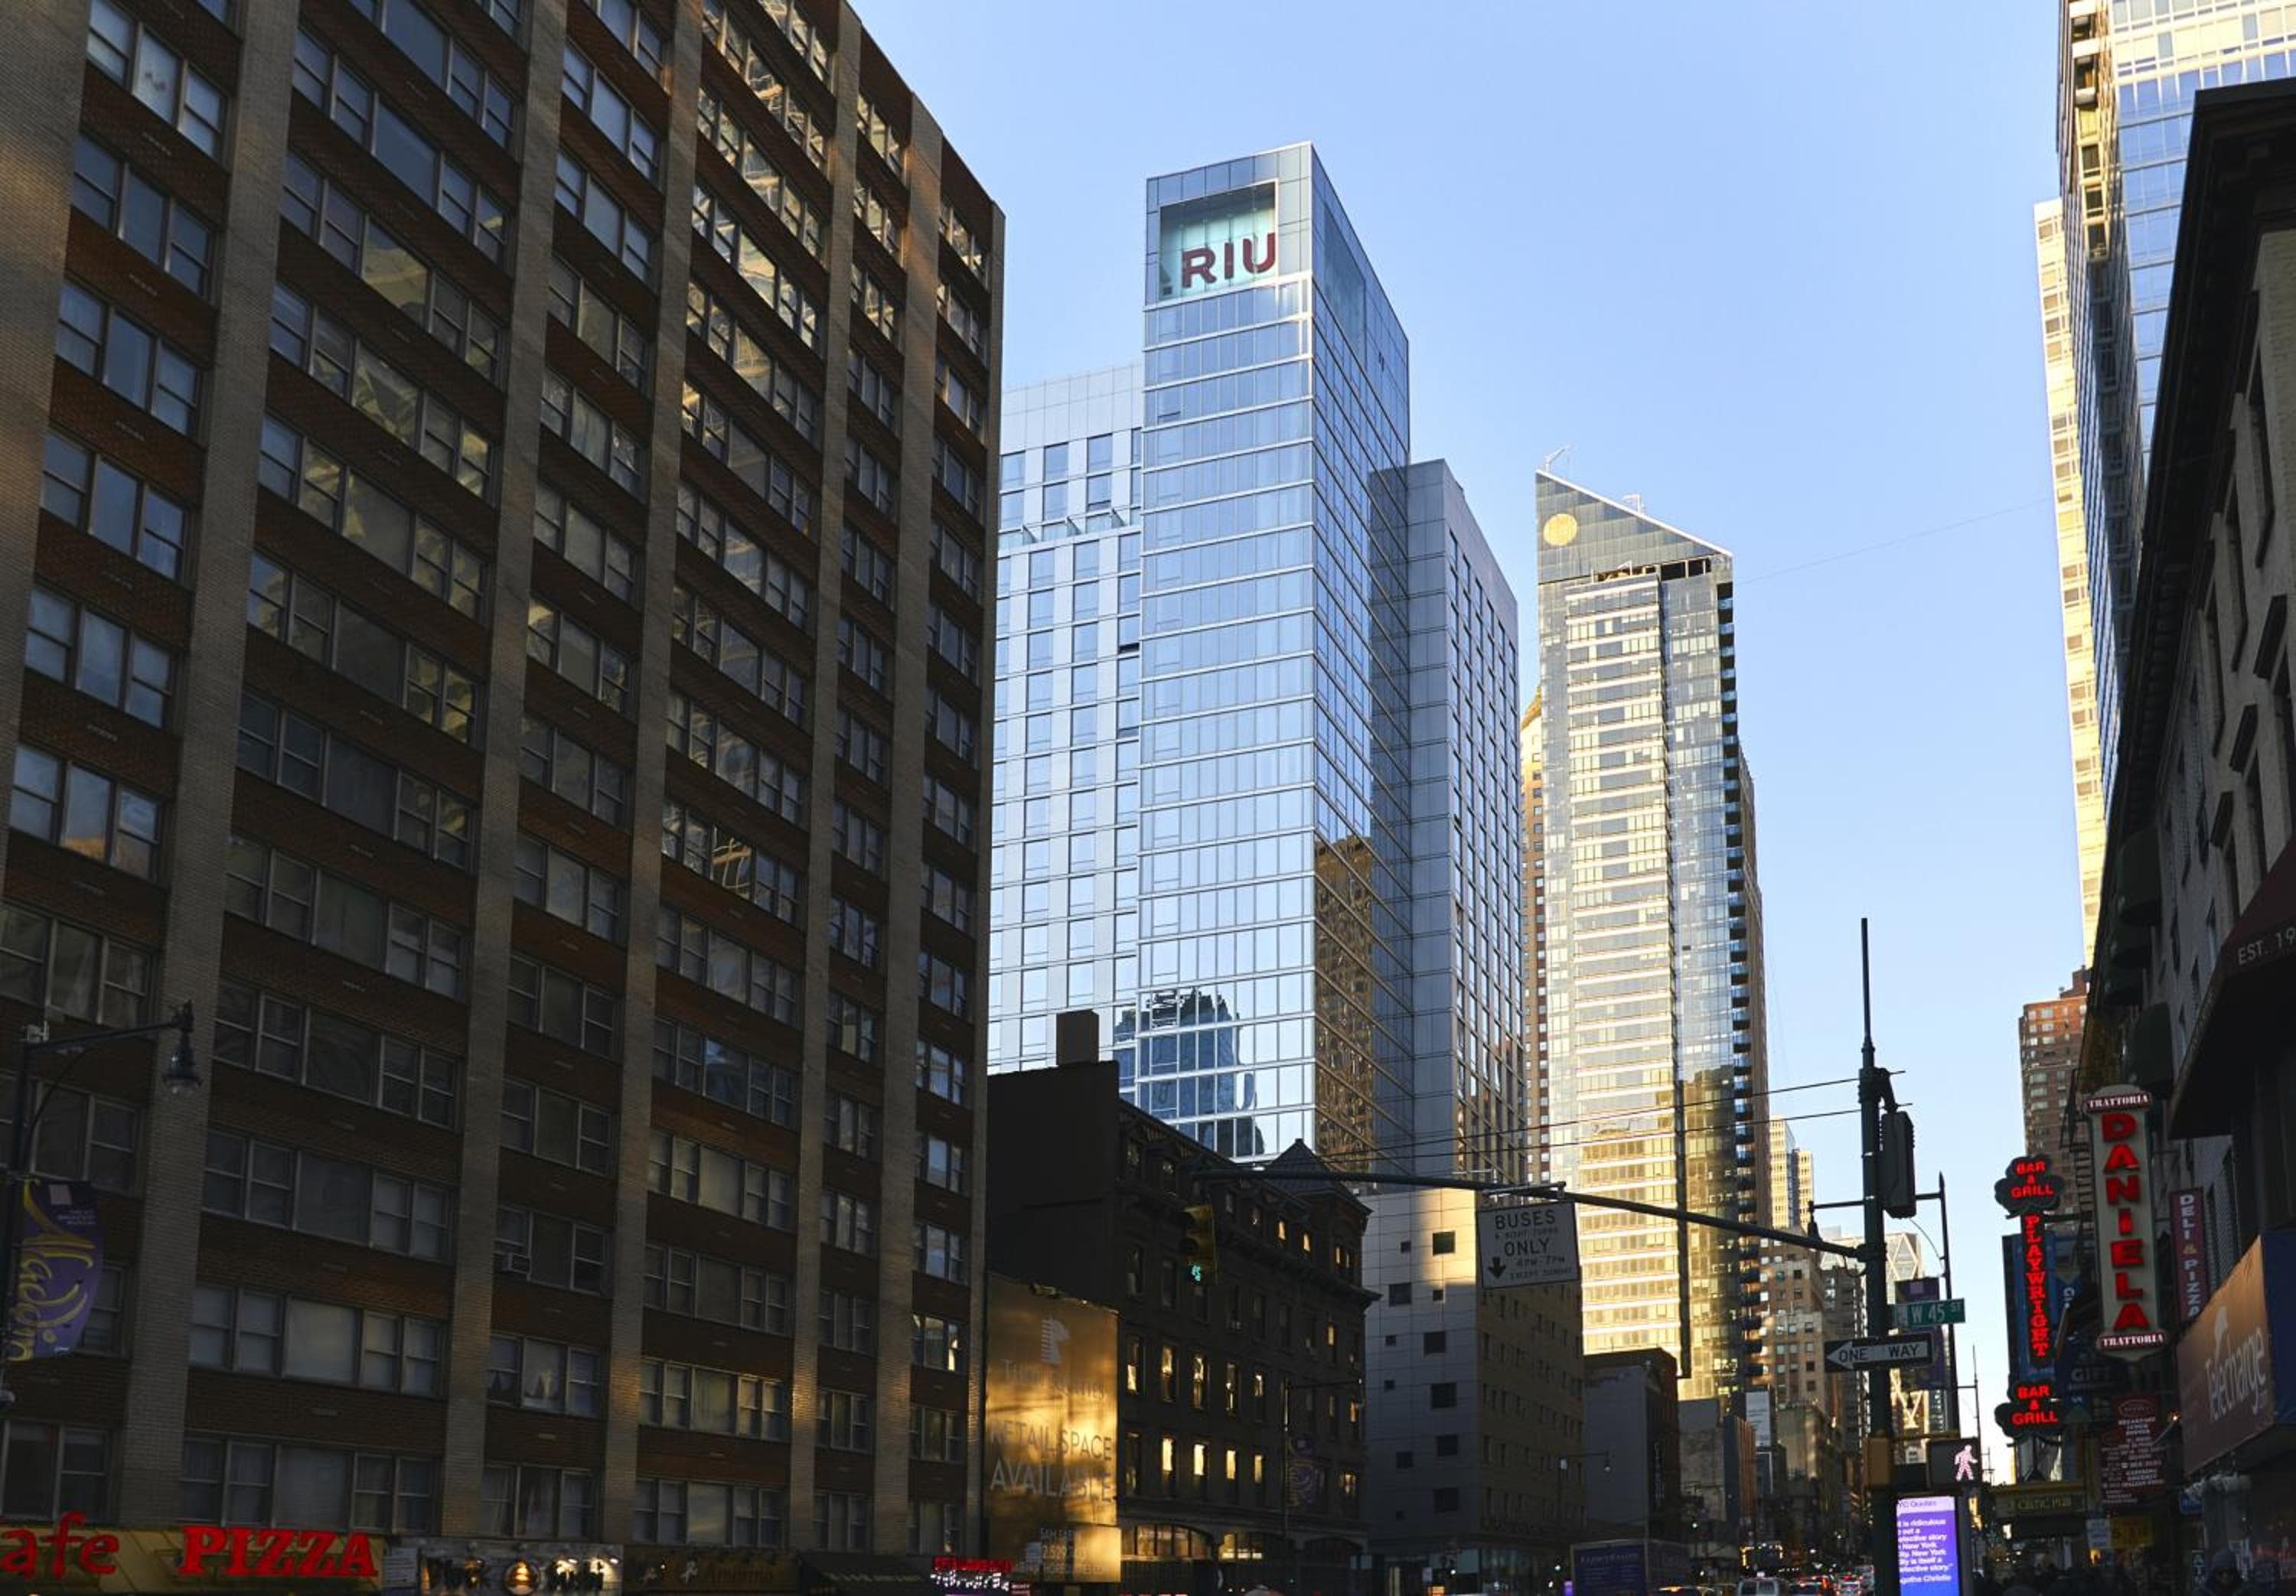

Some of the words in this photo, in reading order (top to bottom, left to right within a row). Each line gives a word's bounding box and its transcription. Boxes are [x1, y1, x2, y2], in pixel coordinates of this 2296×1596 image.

[1181, 233, 1276, 288] RIU
[2238, 940, 2268, 966] EST.
[2087, 1093, 2150, 1109] TRATTORIA
[2017, 1160, 2046, 1176] BAR
[2011, 1182, 2054, 1197] GRILL
[1495, 1208, 1556, 1230] BUSES
[2102, 1112, 2150, 1332] DANIELA
[2180, 1194, 2195, 1239] DELI
[1504, 1237, 1550, 1256] ONLY
[2024, 1215, 2050, 1357] PLAYWRIGHT
[1911, 1304, 1923, 1324] W
[1928, 1303, 1946, 1323] 45
[2101, 1334, 2165, 1347] TRATTORIA
[1838, 1348, 1868, 1363] ONE
[1888, 1345, 1919, 1358] WAY
[2017, 1384, 2050, 1399] BAR
[2011, 1409, 2058, 1425] GRILL
[991, 1419, 1057, 1458] RETAIL
[1061, 1428, 1112, 1461] SPACE
[990, 1456, 1114, 1504] AVAILABLE
[1928, 1534, 1948, 1542] story
[178, 1525, 379, 1578] PIZZA
[1900, 1576, 1923, 1585] gatha
